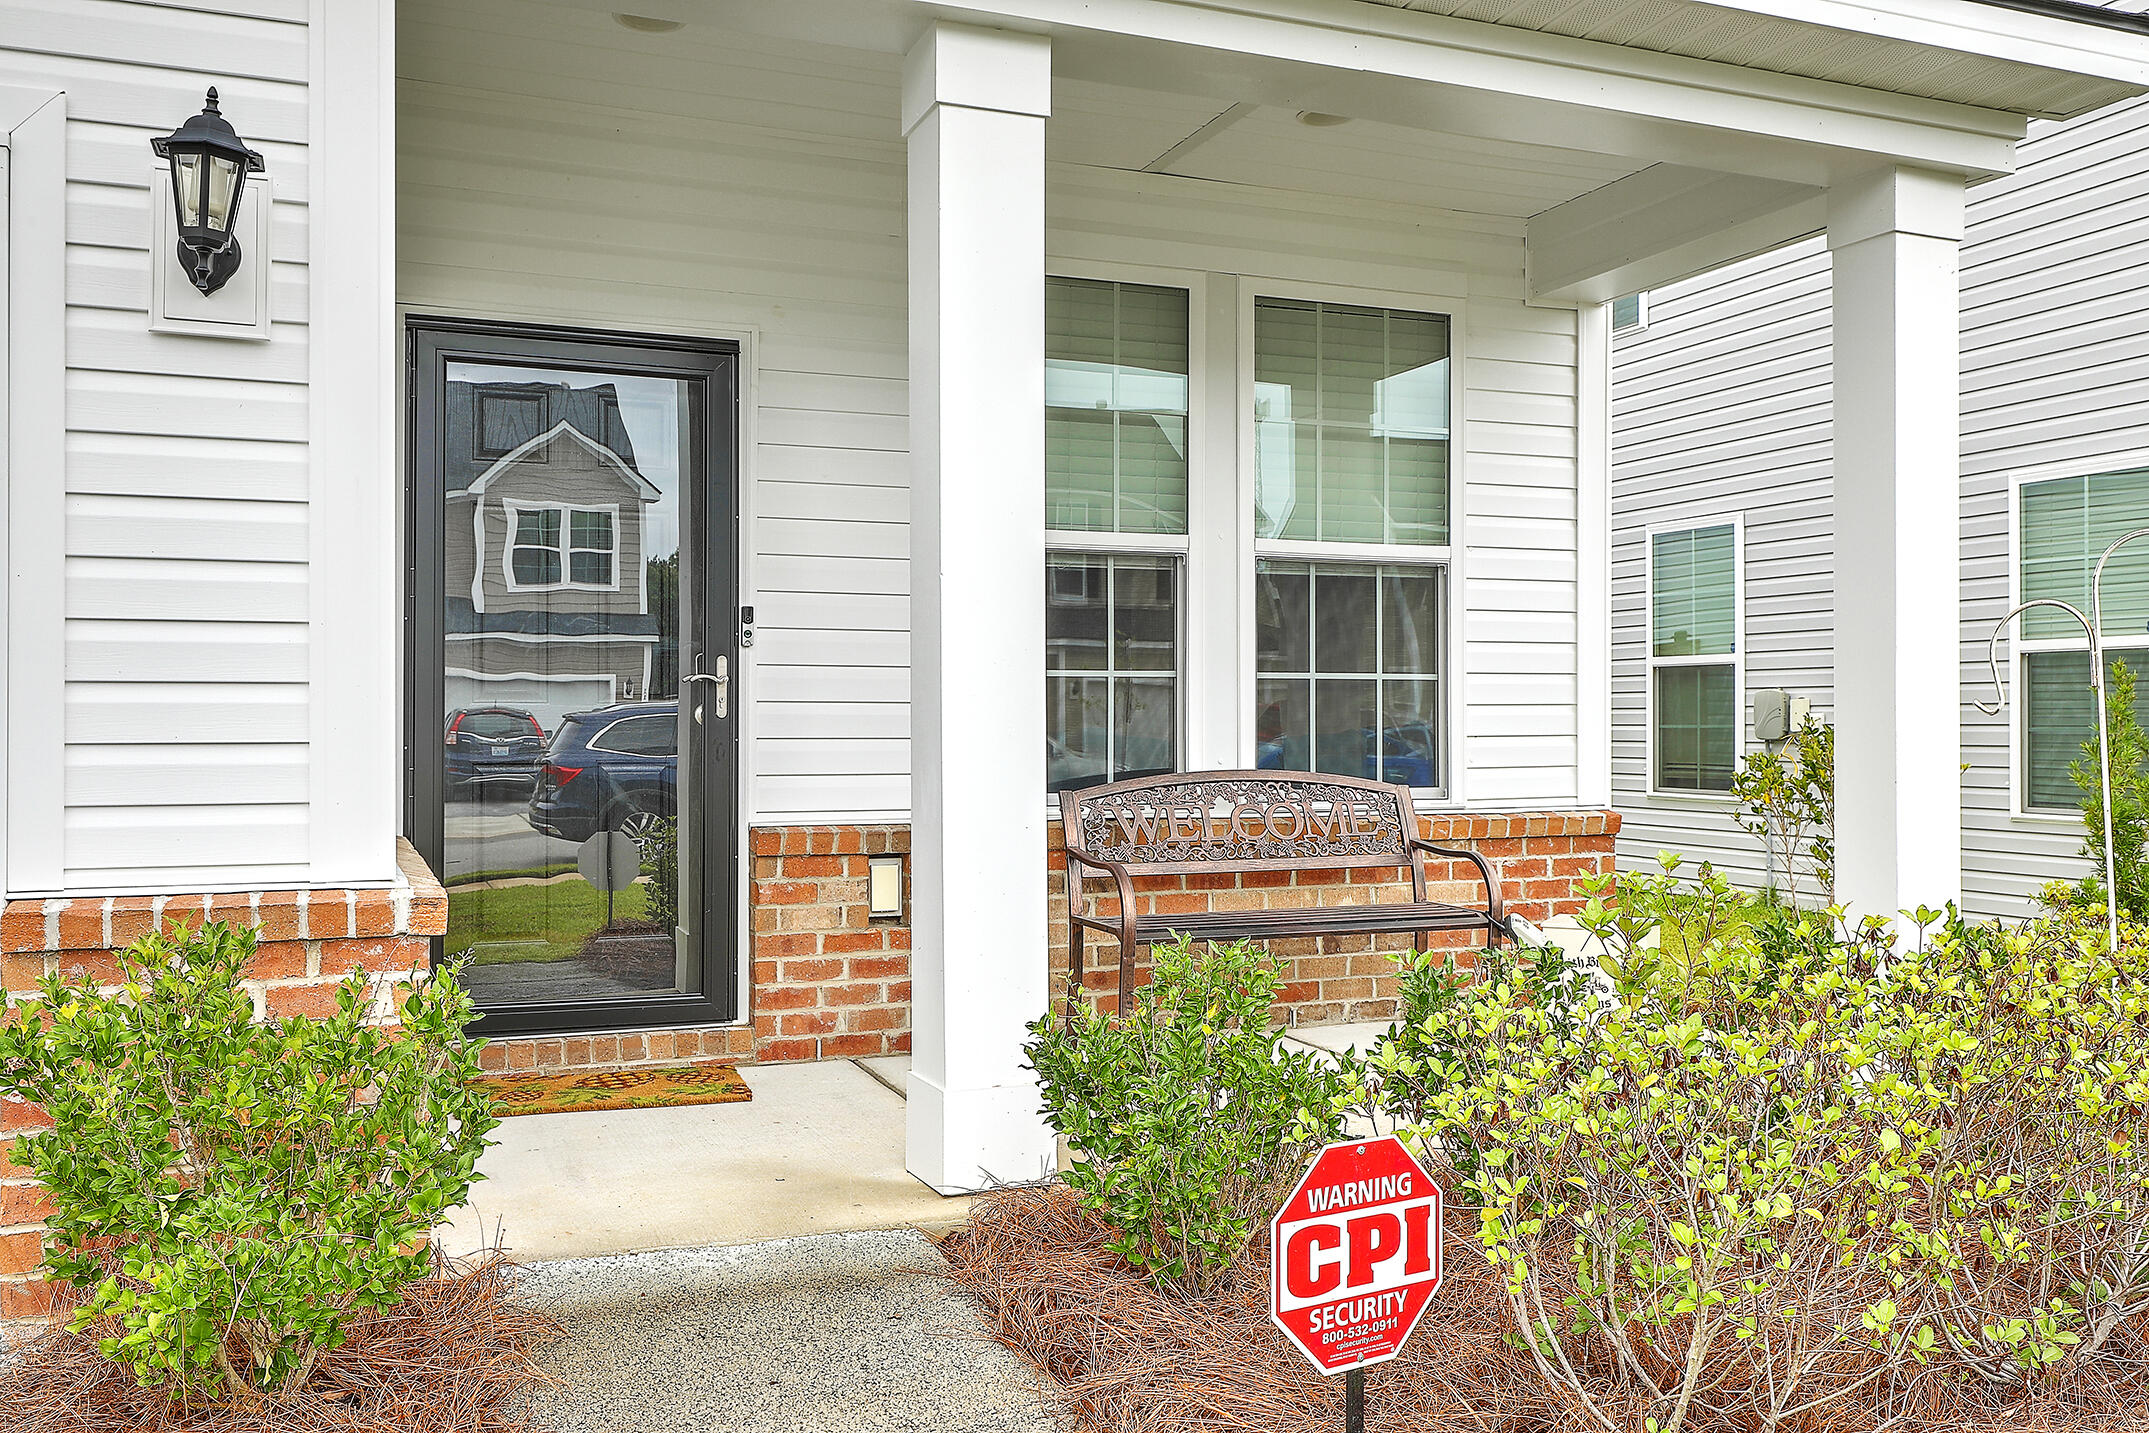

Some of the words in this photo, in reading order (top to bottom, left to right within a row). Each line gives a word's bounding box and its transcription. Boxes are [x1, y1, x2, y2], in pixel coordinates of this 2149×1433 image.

[1103, 800, 1383, 845] WELCOME
[1307, 1172, 1412, 1213] WARNING
[1287, 1204, 1430, 1298] CPI
[1309, 1289, 1408, 1333] SECURITY
[1322, 1316, 1398, 1344] 800-532-0911
[1336, 1334, 1383, 1350] cpisecurity.com
